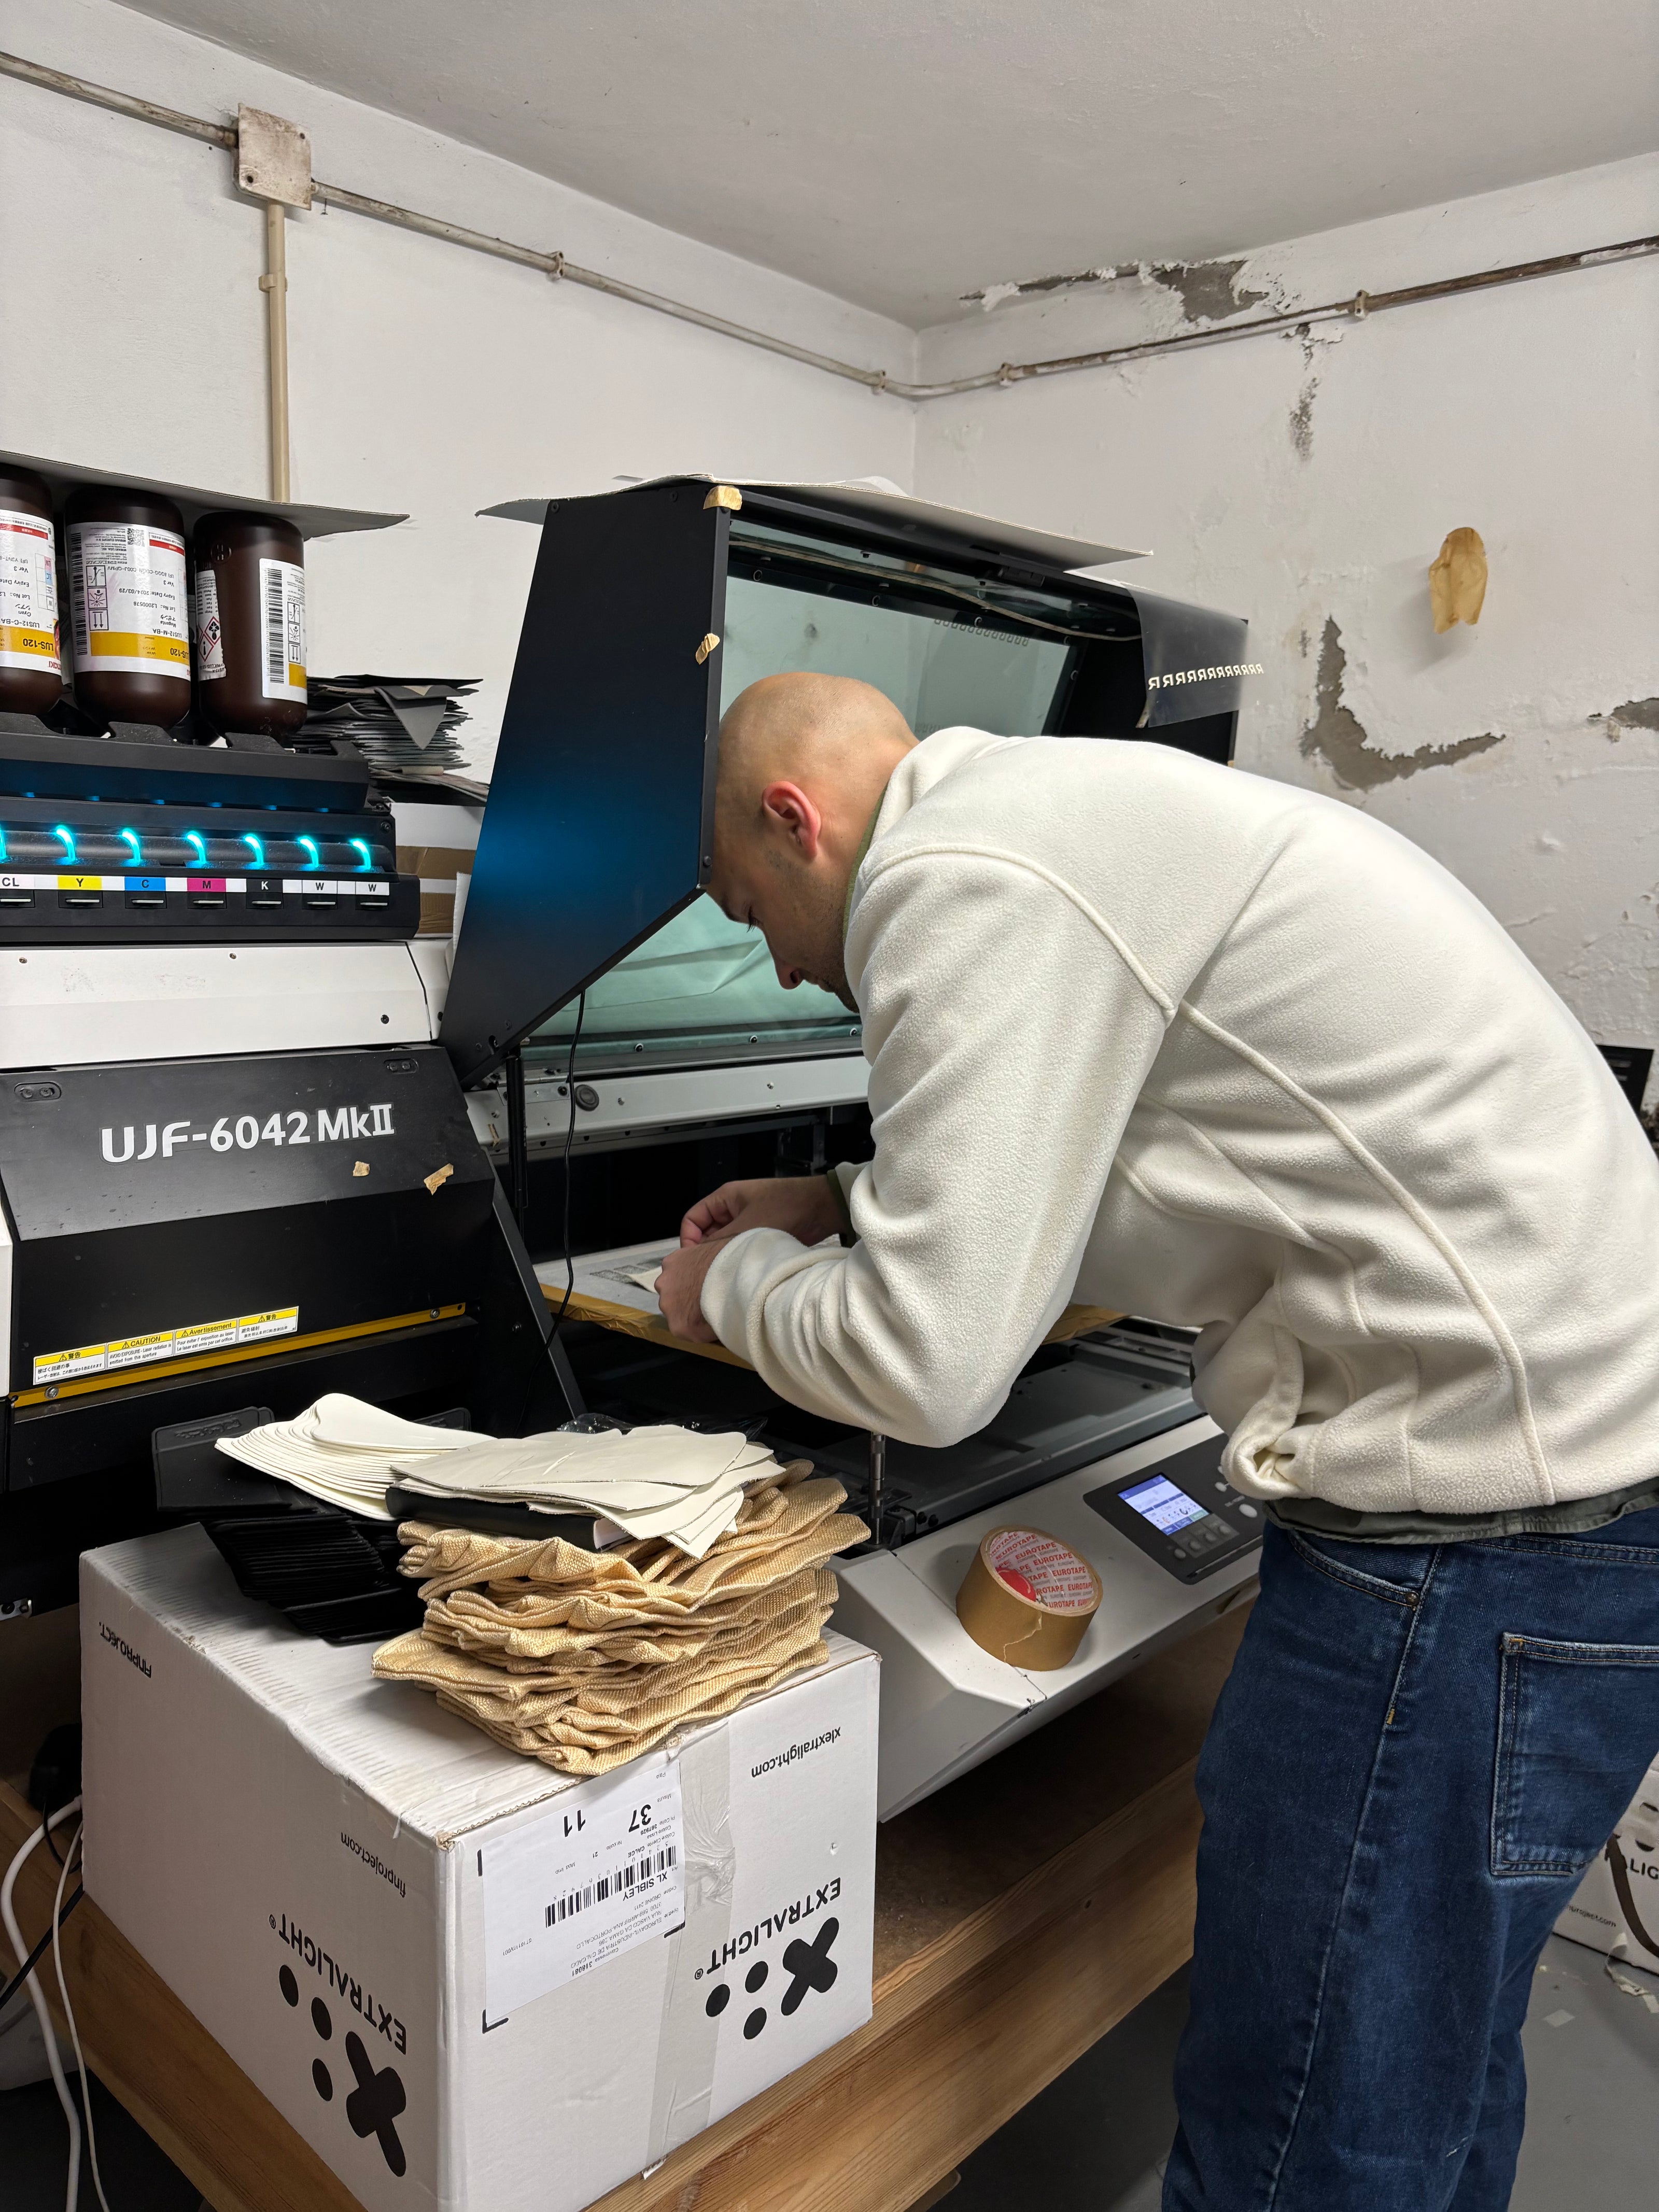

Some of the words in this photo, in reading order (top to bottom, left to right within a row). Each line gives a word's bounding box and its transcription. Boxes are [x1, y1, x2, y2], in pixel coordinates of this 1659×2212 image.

[23, 639, 54, 651] LUS-120
[2, 877, 20, 887] CL
[76, 878, 84, 887] Y
[142, 879, 149, 889] C
[203, 880, 211, 889] M
[261, 881, 269, 890] K
[316, 882, 325, 891] W
[102, 1111, 311, 1163] UJF-6042
[189, 1322, 232, 1335] Avertissement
[131, 1336, 161, 1347] CAUTION
[121, 1349, 140, 1357] EXPOSURE
[1015, 1542, 1057, 1560] EUROTAPE
[1033, 1552, 1073, 1566] EUROTAPE
[1051, 1566, 1086, 1576] EUROTAPE
[751, 1727, 841, 1778] xlextralight.com
[564, 1809, 586, 1838] 11
[628, 1804, 652, 1833] 37
[628, 1845, 645, 1858] CALCE
[341, 1832, 406, 1898] finproject.com
[656, 1871, 667, 1883] XL
[622, 1878, 654, 1901] SIBLEY
[644, 1893, 662, 1906] ORDINE
[651, 1910, 662, 1918] RUA
[632, 1916, 651, 1927] VASCO
[571, 1961, 593, 1977] 318081
